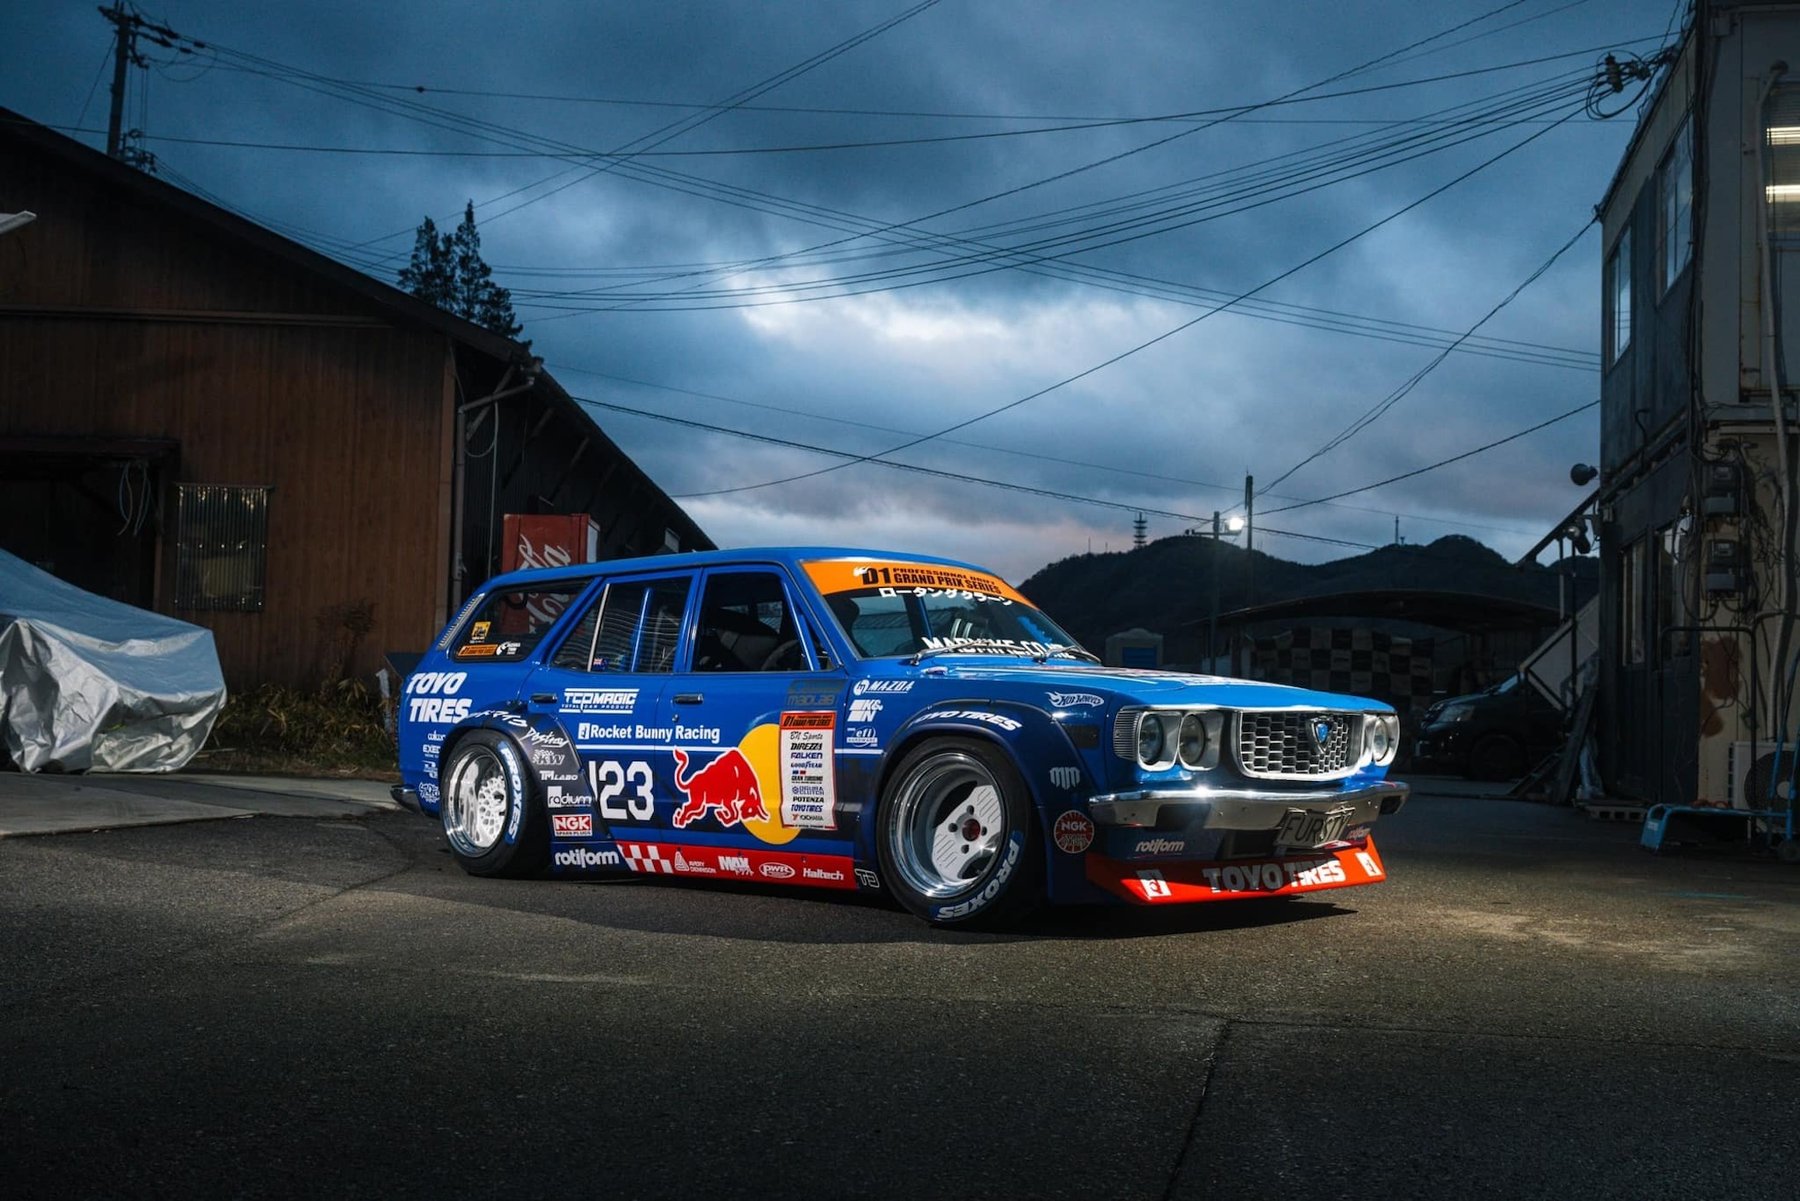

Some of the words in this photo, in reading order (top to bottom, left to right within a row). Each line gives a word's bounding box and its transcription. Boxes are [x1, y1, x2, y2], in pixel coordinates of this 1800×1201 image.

[862, 567, 891, 585] D1
[893, 567, 968, 580] PROFESSIONAL
[894, 573, 935, 585] GRAND
[937, 575, 965, 588] PRIX
[965, 579, 1003, 595] SERIES
[405, 672, 468, 695] TOYO
[867, 680, 916, 692] MAZDA
[408, 698, 473, 724] TIRES
[956, 711, 1023, 731] TIRES
[591, 724, 632, 740] Rocket
[635, 725, 673, 743] Bunny
[674, 725, 720, 744] Racing
[790, 742, 823, 751] DIREZZA
[790, 752, 823, 760] FALKEN
[790, 760, 823, 769] GOODYEAR
[499, 747, 523, 841] PROXES
[548, 793, 592, 805] radium
[792, 796, 825, 804] POTENZA
[555, 816, 591, 831] NGK
[1061, 821, 1087, 832] NGK
[1134, 839, 1185, 854] rotiform
[554, 847, 621, 868] rotiform
[802, 867, 845, 881] Haltech
[933, 838, 1021, 922] PROXES
[1202, 864, 1284, 893] TOYO
[1283, 860, 1346, 887] TIRES
